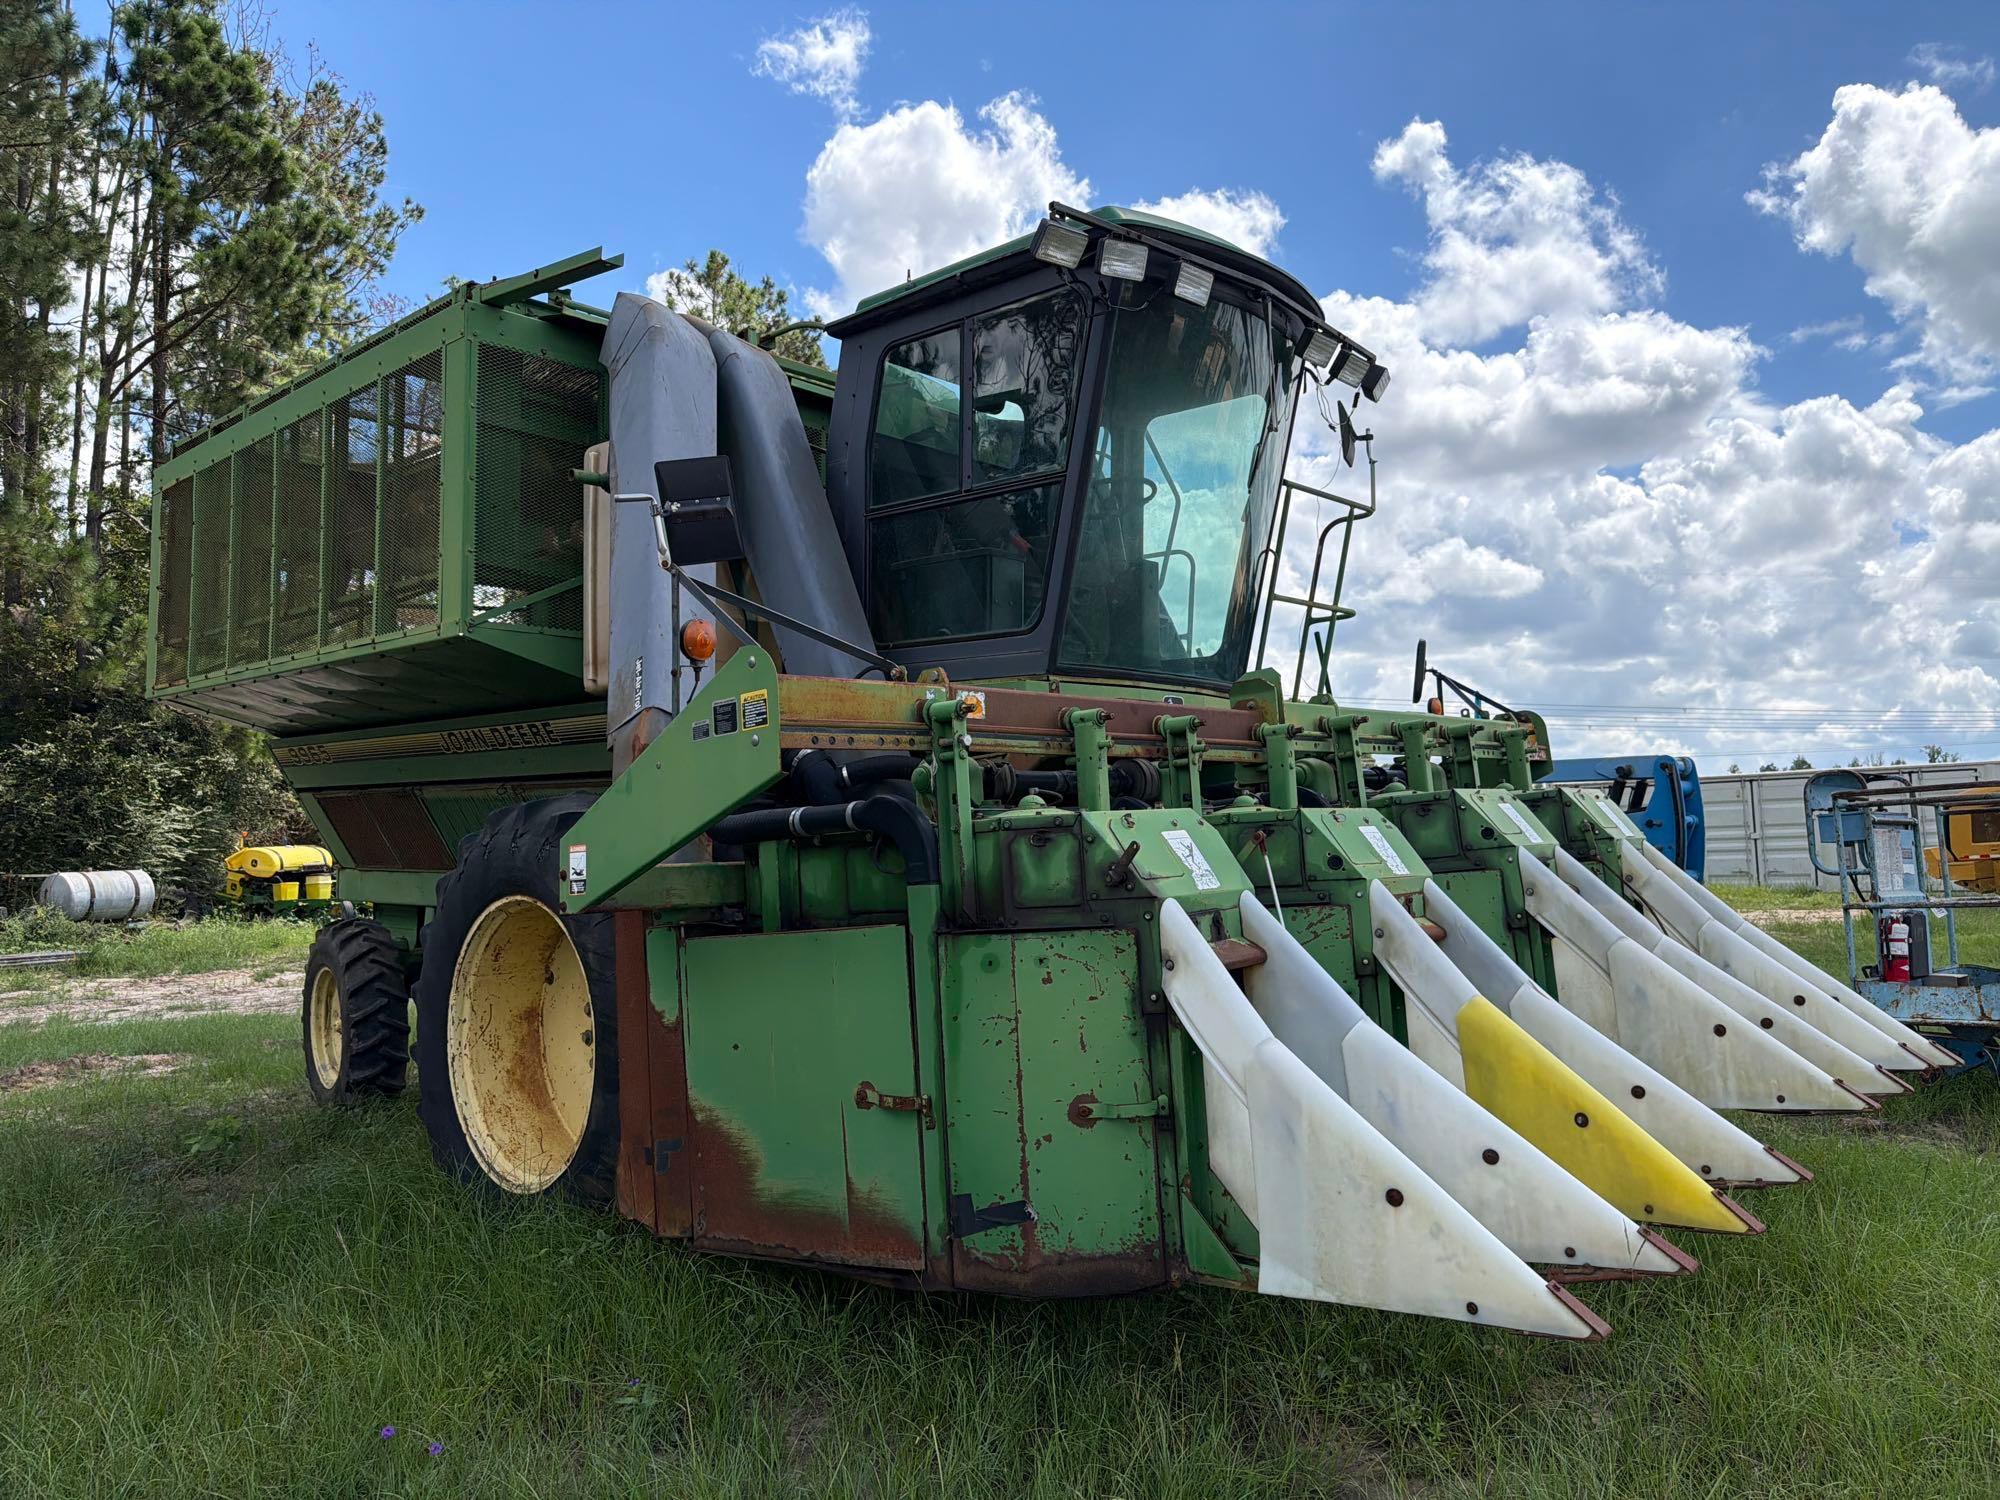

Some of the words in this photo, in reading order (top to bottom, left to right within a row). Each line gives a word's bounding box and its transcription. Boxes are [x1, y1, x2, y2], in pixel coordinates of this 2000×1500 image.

[440, 729, 491, 753] JOHN
[491, 721, 561, 748] DEERE
[288, 745, 332, 765] 9965
